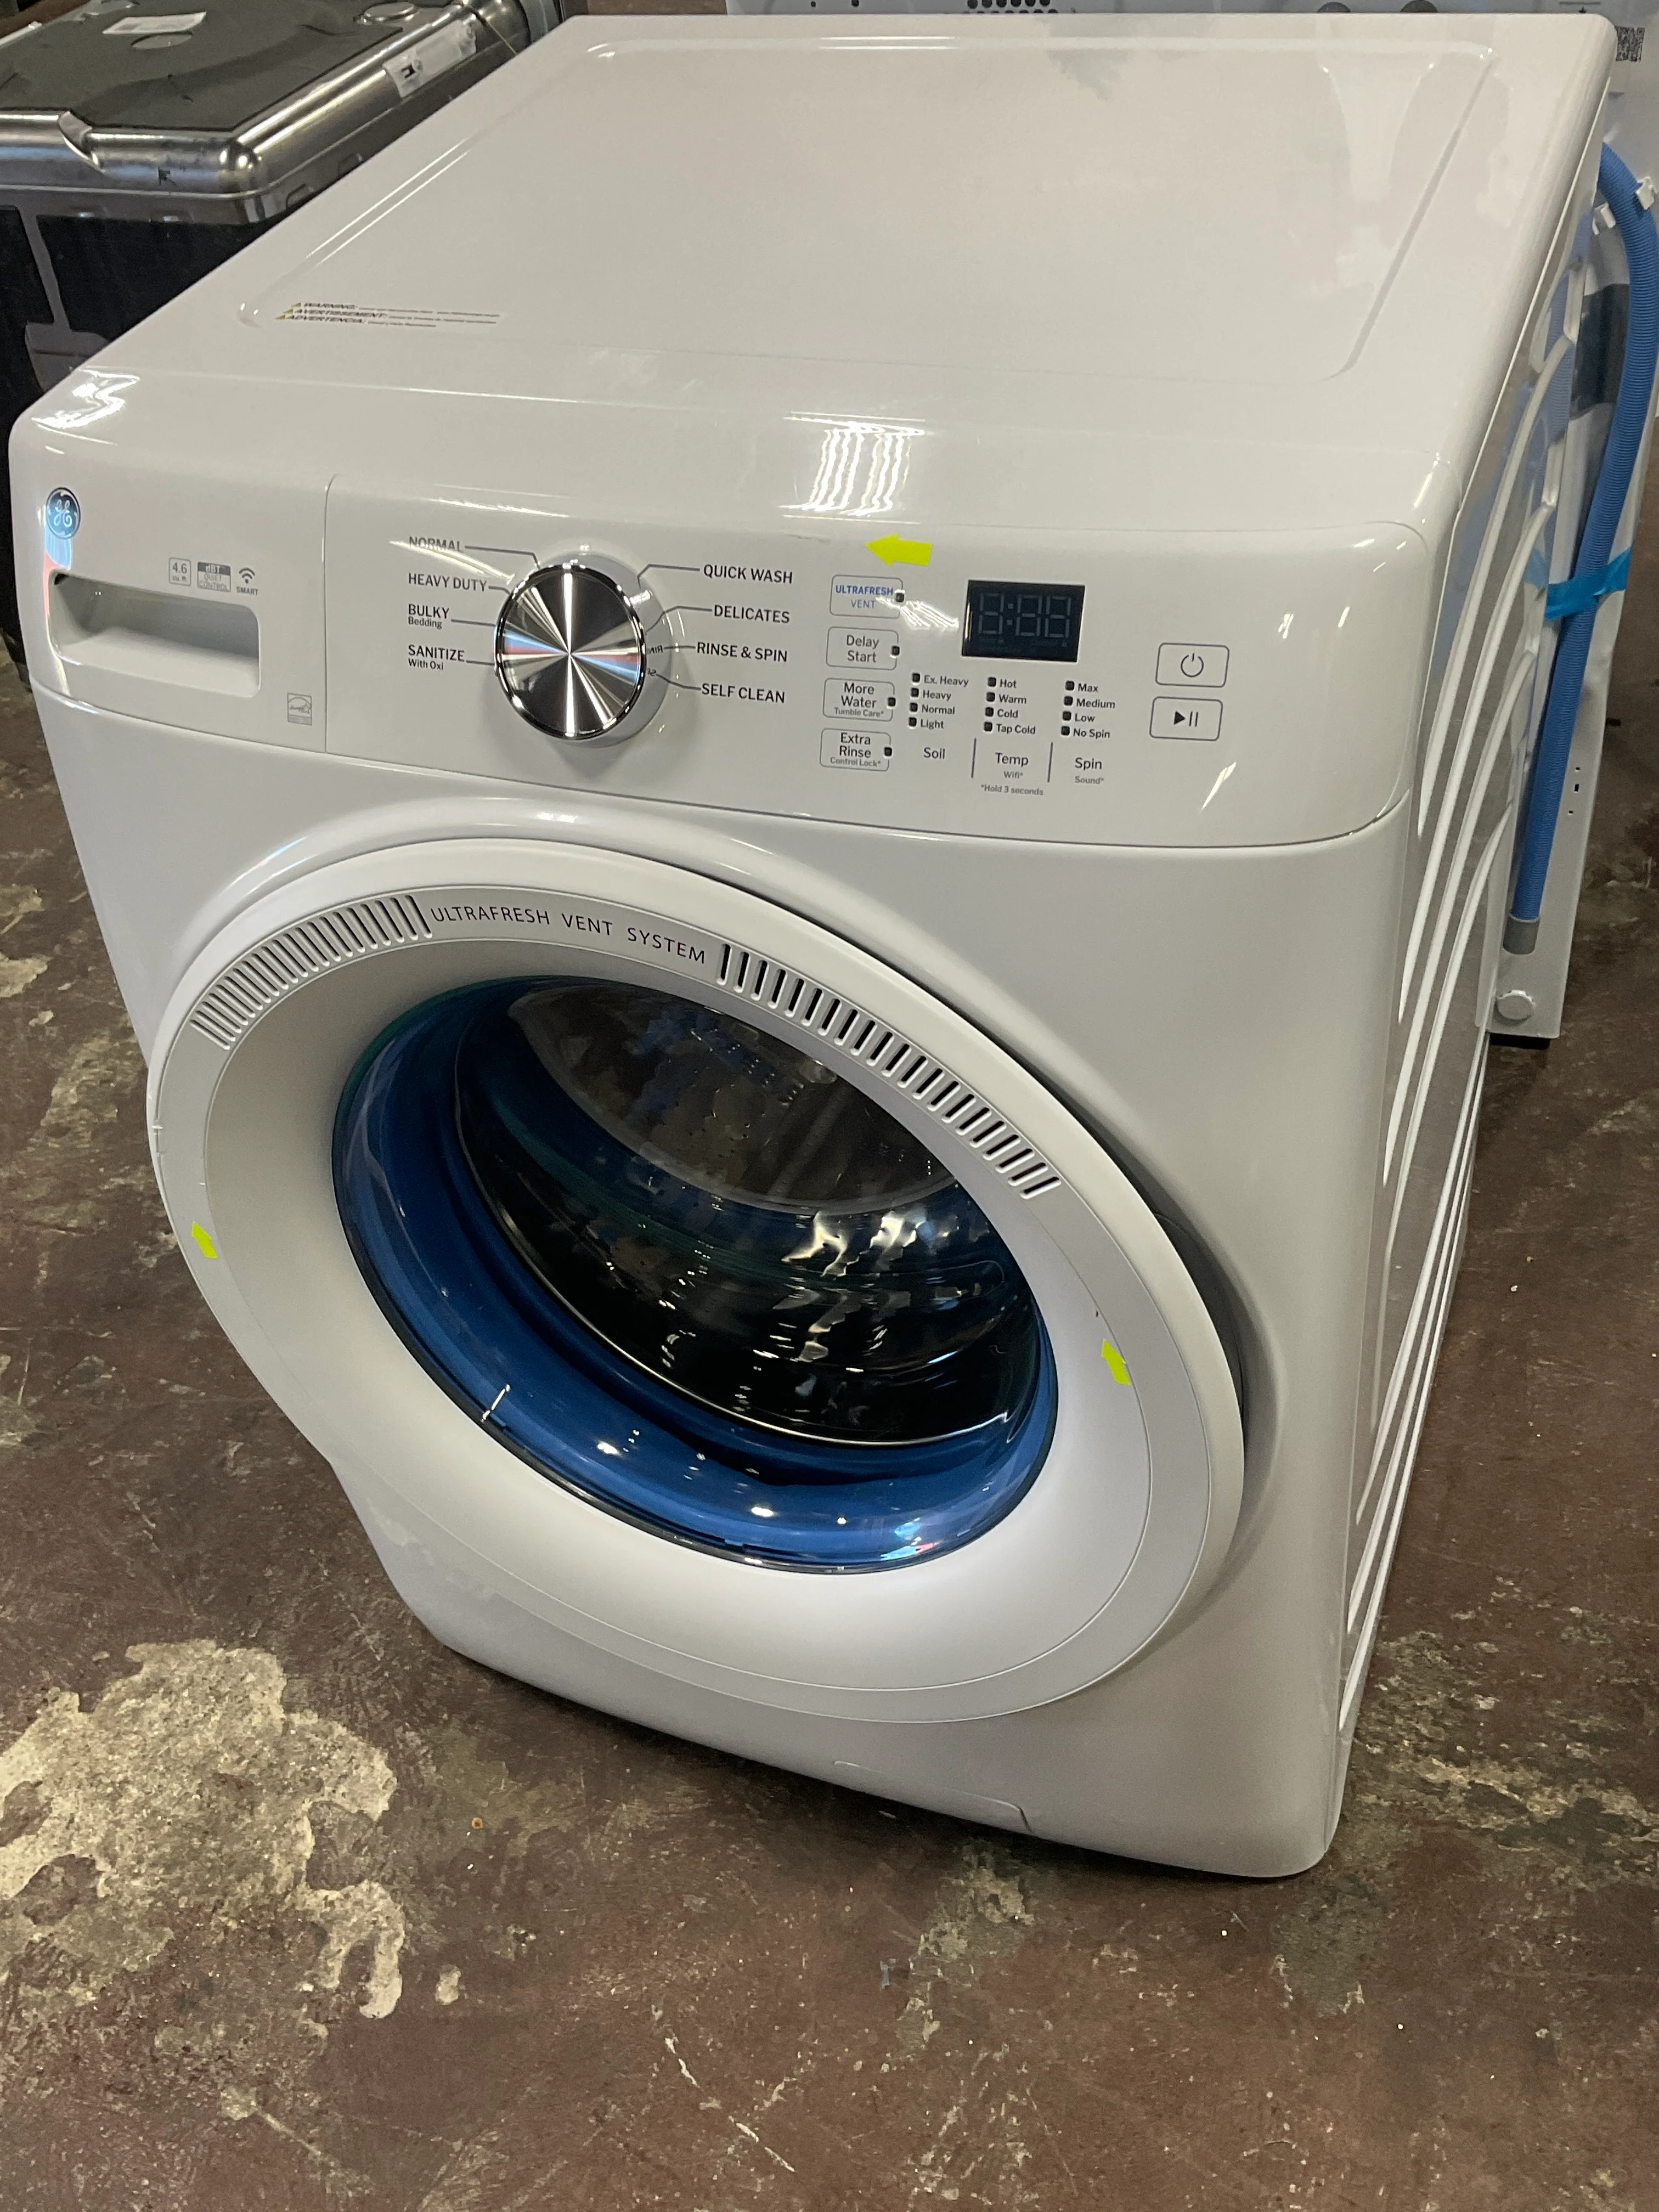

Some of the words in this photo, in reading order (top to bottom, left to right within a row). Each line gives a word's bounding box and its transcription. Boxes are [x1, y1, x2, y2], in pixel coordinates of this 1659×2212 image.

[409, 536, 461, 552] NORMAL
[704, 564, 746, 580] QUICK
[751, 568, 792, 584] WASH
[409, 573, 449, 588] HEAVY
[453, 577, 487, 592] DUTY
[236, 586, 258, 595] SMART
[836, 585, 894, 596] ULTRAFRESH
[851, 599, 876, 609] VENT
[409, 604, 449, 619] BULKY
[714, 605, 790, 623] DELICATES
[408, 617, 442, 630] Bedding
[847, 635, 879, 649] Delay
[408, 645, 465, 662] SANITIZE
[697, 641, 737, 657] RINSE
[741, 646, 752, 659] &
[755, 648, 787, 662] SPIN
[847, 651, 877, 663] Start
[409, 658, 428, 669] With
[430, 661, 444, 670] Oxi
[924, 675, 938, 685] Ex.
[940, 675, 969, 687] Heavy
[1000, 679, 1017, 689] Hot
[702, 684, 735, 697] SELF
[738, 687, 785, 703] CLEAN
[844, 682, 874, 695] More
[1077, 683, 1098, 692] Max
[923, 690, 952, 701] Heavy
[999, 694, 1026, 704] Warm
[841, 696, 877, 708] Water
[1076, 698, 1115, 709] Medium
[834, 708, 861, 716] Tumble
[922, 704, 955, 714] Normal
[997, 709, 1018, 718] Cold
[1075, 713, 1095, 722] Low
[921, 719, 944, 730] Light
[996, 724, 1012, 735] Tap
[1015, 724, 1036, 735] Cold
[840, 732, 871, 746] Extra
[1073, 728, 1087, 737] No
[1089, 729, 1110, 740] Spin
[839, 746, 871, 758] Rinse
[923, 747, 945, 759] Soil
[830, 757, 857, 766] Control
[995, 752, 1029, 767] Temp
[1075, 757, 1102, 770] Spin
[1011, 787, 1043, 795] seconds
[430, 906, 550, 925] ULTRAFRESH
[561, 912, 613, 936] VENT
[627, 927, 706, 964] SYSTEM
